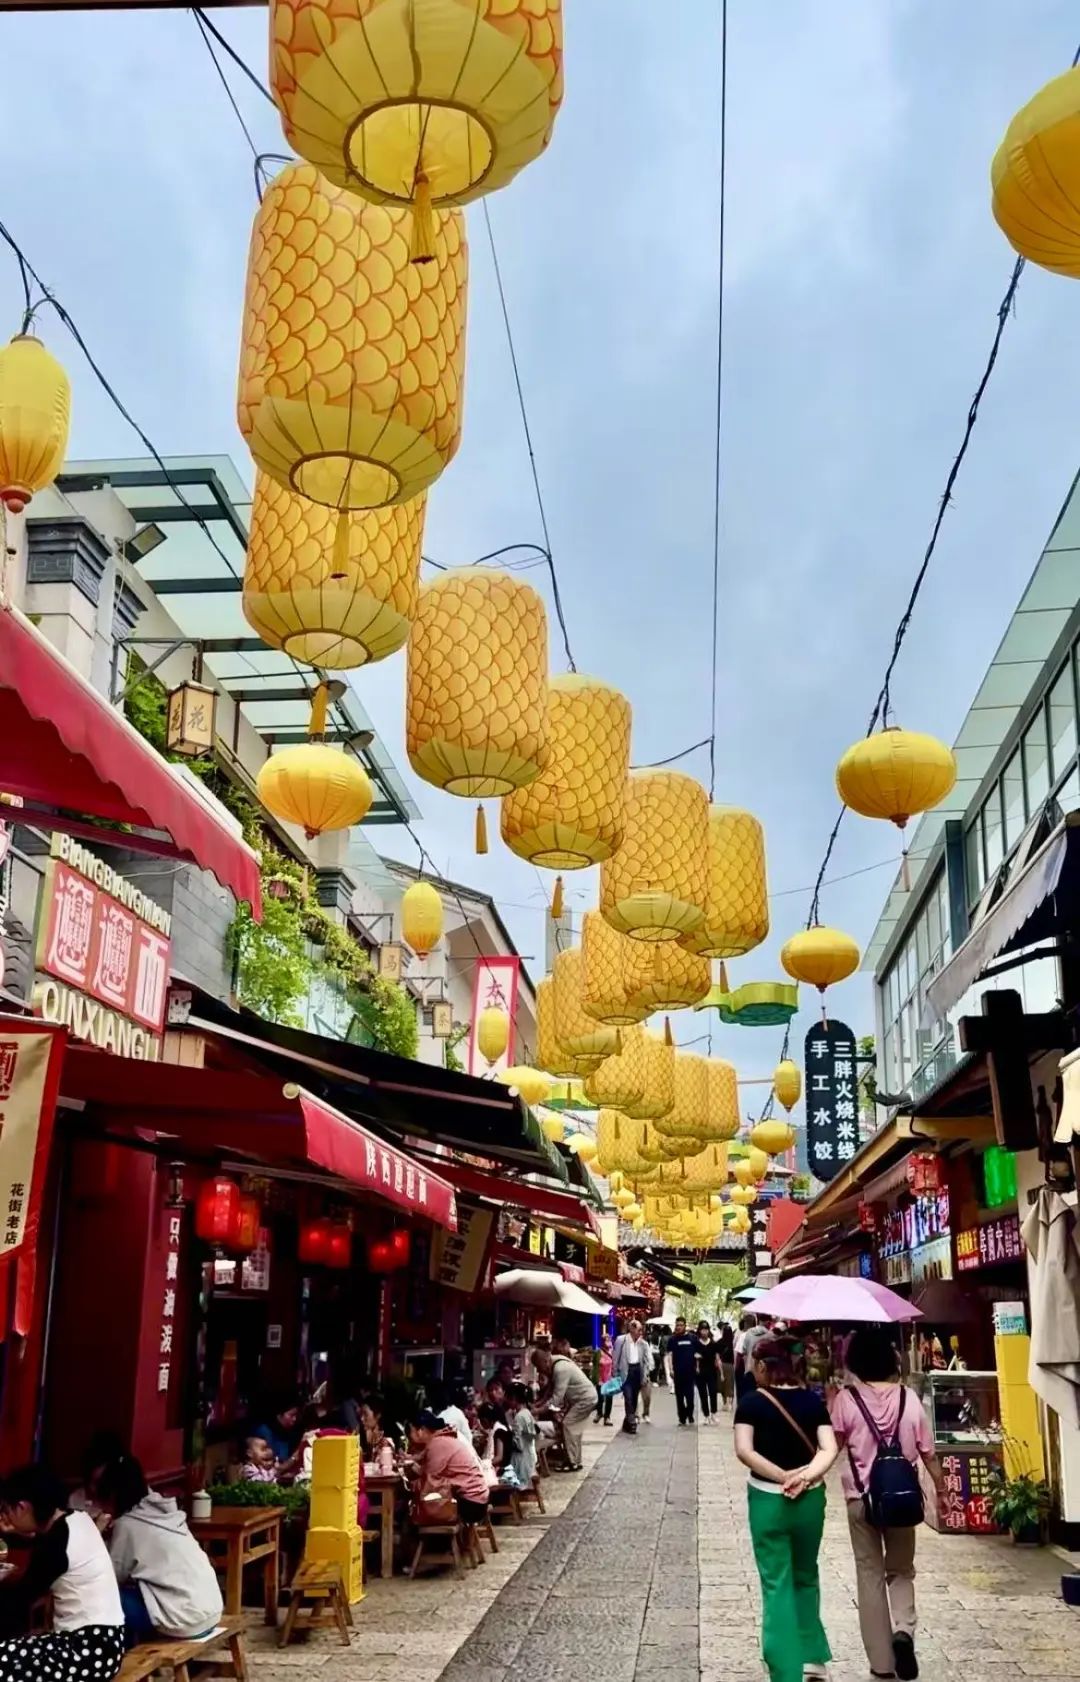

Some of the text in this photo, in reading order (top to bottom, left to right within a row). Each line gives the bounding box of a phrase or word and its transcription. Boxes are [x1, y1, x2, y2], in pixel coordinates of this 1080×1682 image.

[810, 1040, 833, 1160] 手工水饺
[834, 1041, 856, 1160] 三胖火烧米线
[4, 1182, 24, 1245] 花街老店
